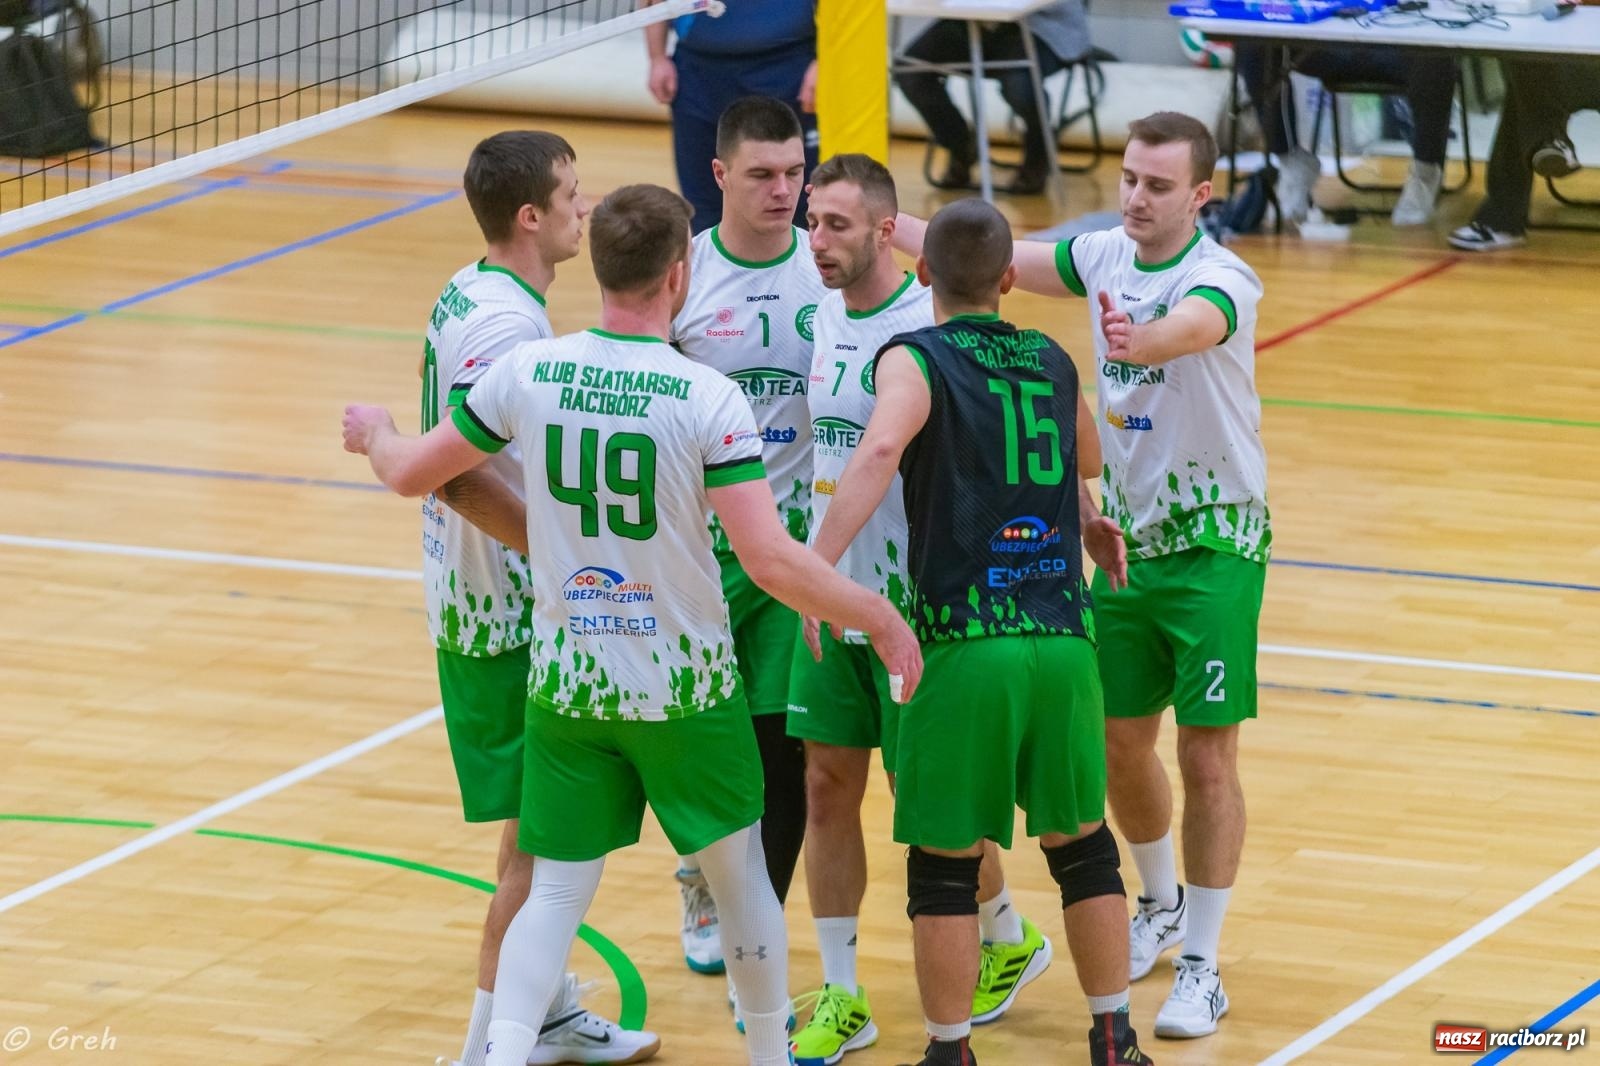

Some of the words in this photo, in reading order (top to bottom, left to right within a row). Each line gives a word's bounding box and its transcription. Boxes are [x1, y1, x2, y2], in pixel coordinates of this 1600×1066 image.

[746, 294, 780, 302] DECATHLON
[706, 329, 745, 337] Racibórz
[758, 312, 770, 348] 1
[532, 360, 577, 385] KLUB
[580, 365, 692, 401] SIATKARSKI
[832, 361, 847, 397] 7
[559, 386, 653, 418] RACIBÓRZ
[987, 378, 1064, 486] 15
[545, 423, 658, 541] 49
[563, 589, 654, 603] UBEZPIECZENIA
[617, 583, 652, 592] MULTI
[569, 616, 656, 635] ENTECO
[1205, 660, 1225, 702] 2
